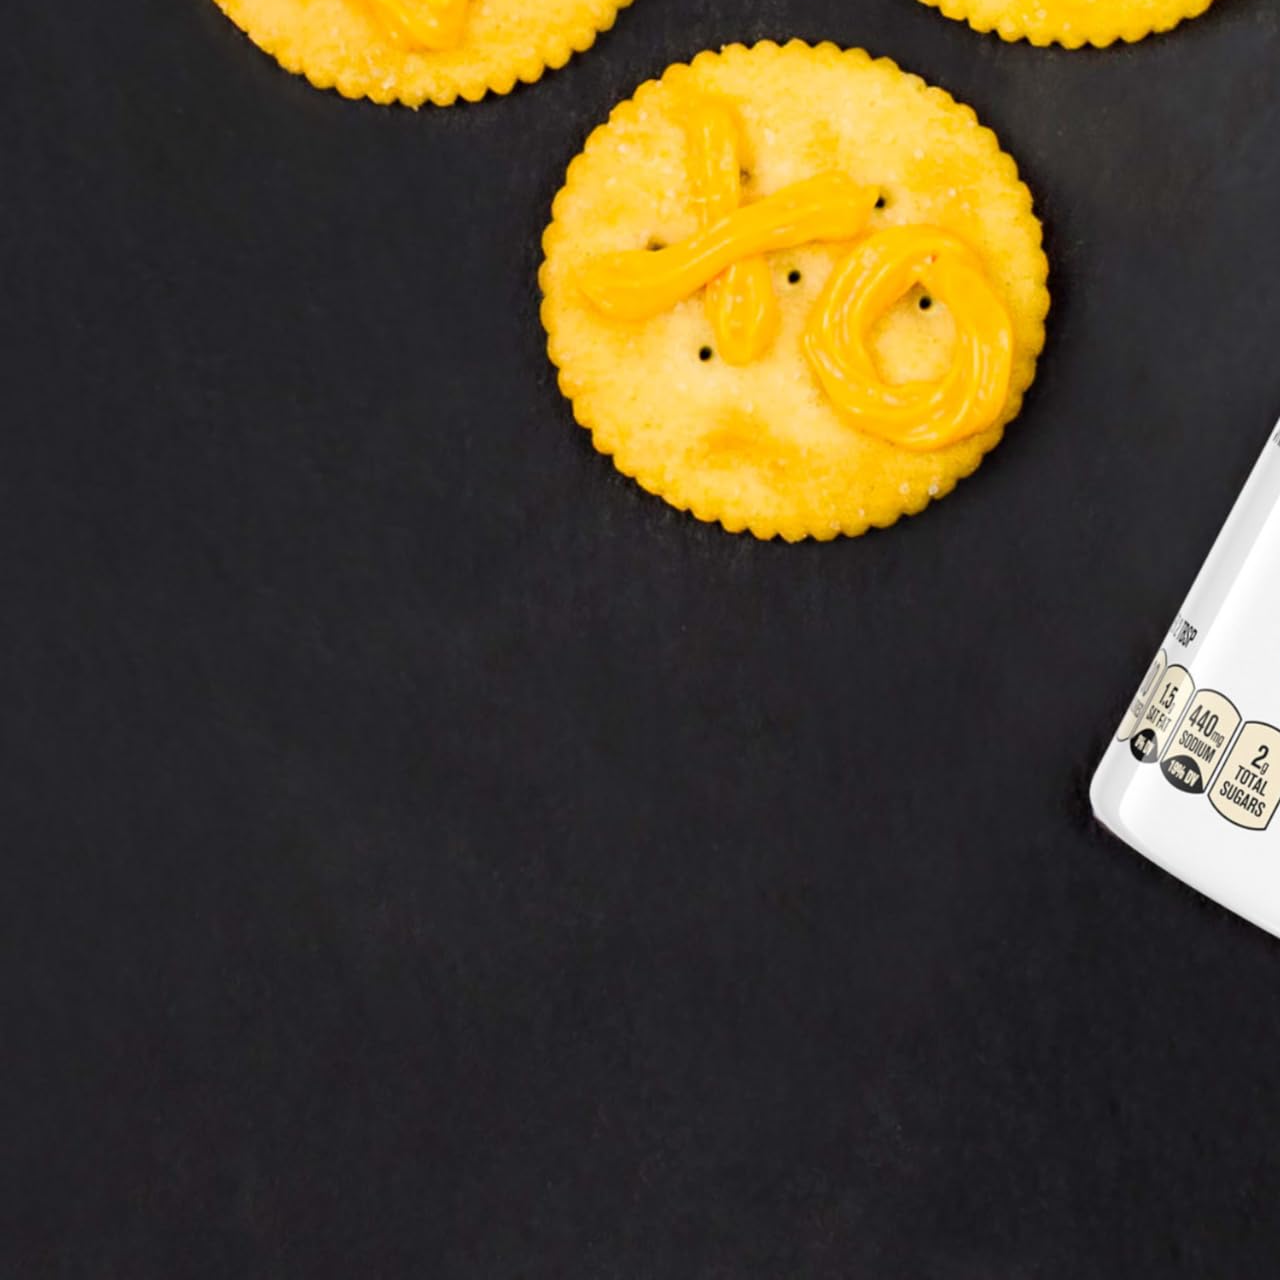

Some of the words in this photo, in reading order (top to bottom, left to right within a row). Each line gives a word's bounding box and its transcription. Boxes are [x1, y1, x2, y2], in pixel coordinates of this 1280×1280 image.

[1179, 730, 1216, 764] SODIUM
[1232, 765, 1269, 797] TOTAL
[1220, 780, 1266, 818] SUGARS
